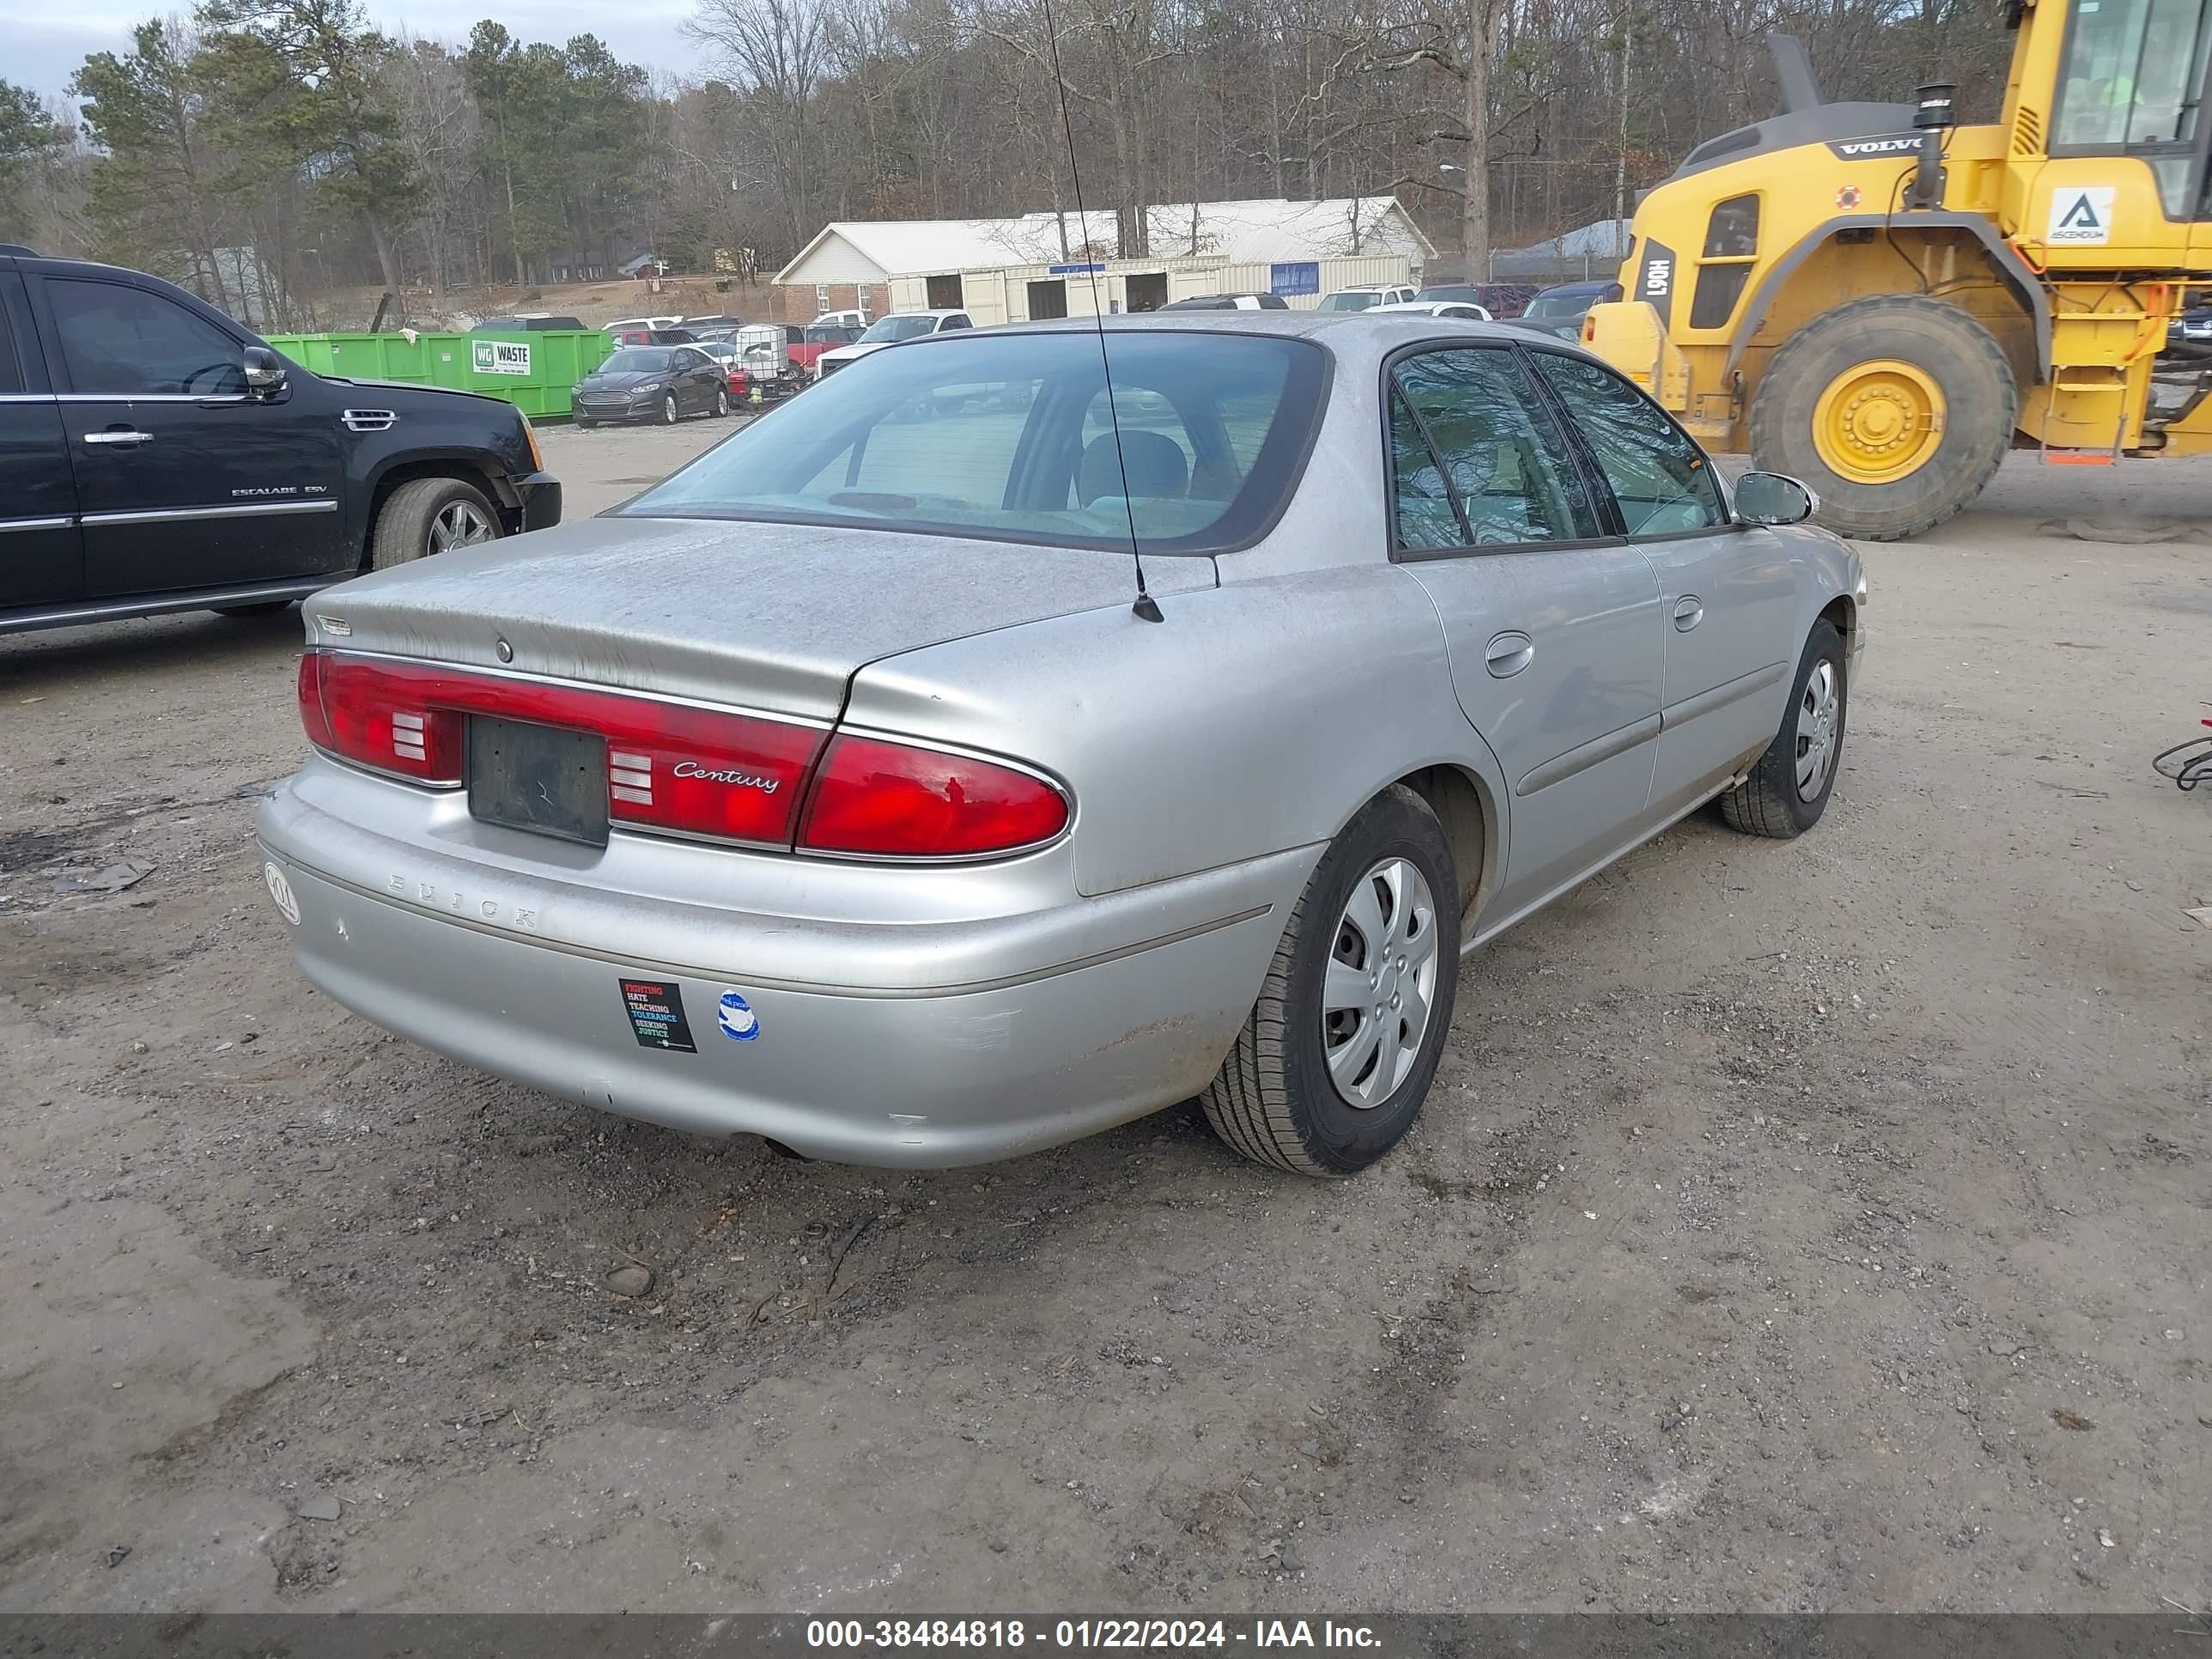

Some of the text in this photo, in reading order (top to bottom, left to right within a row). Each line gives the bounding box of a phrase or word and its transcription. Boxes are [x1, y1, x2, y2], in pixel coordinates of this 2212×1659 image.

[1646, 260, 1670, 295] L90H
[477, 347, 492, 362] WG
[497, 346, 527, 362] WASTE
[231, 487, 297, 496] ESCALADE
[673, 762, 779, 794] Century
[388, 874, 536, 927] BUICK
[624, 984, 664, 995] FIGHTING
[626, 993, 648, 1002] HATE
[629, 1002, 670, 1014] TEACHING
[631, 1011, 678, 1023] TOLERANCE
[635, 1019, 668, 1030] SEEKING
[638, 1028, 670, 1038] JUSTICE
